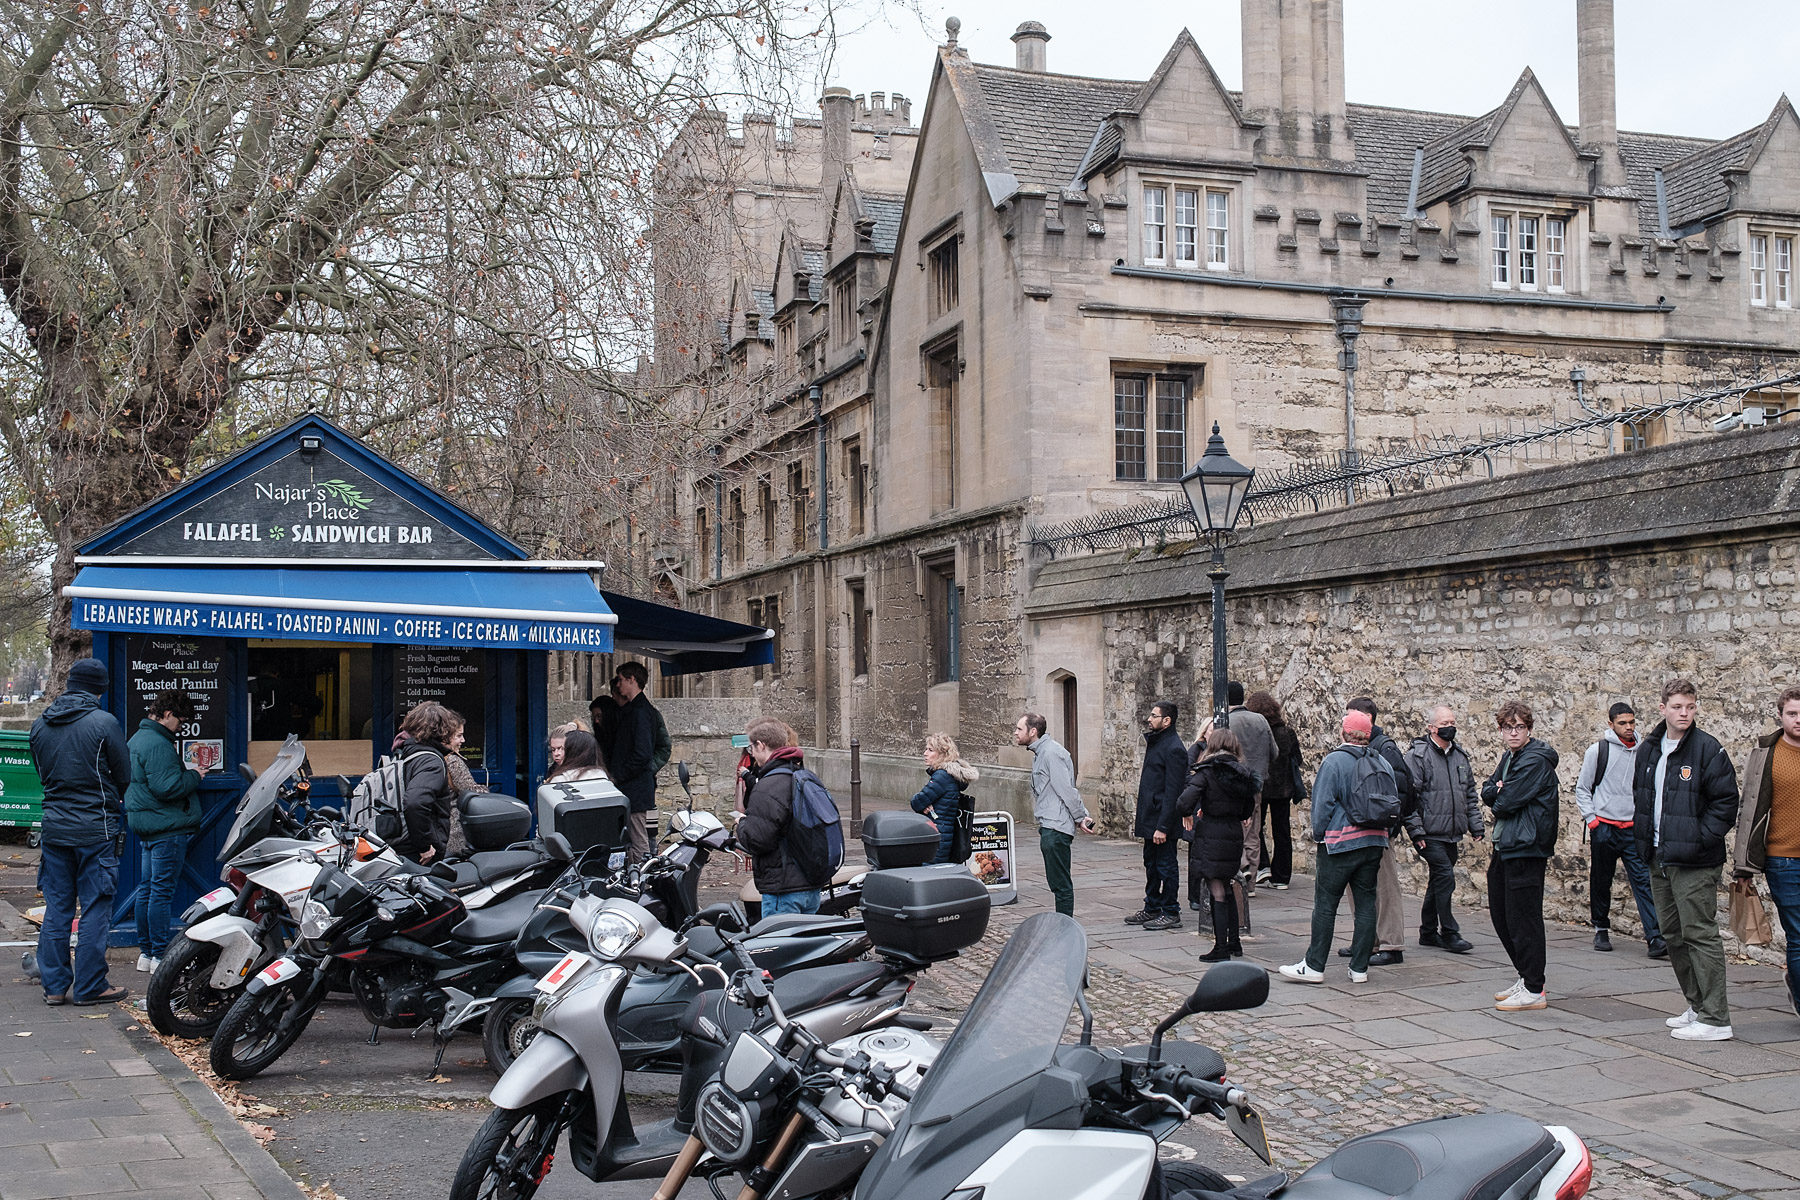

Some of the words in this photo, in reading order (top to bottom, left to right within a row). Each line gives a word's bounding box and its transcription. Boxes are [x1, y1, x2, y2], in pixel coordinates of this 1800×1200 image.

[254, 482, 327, 505] Najar's
[307, 501, 360, 520] Place
[183, 522, 262, 542] FALAFEL
[291, 524, 390, 543] SANDWICH
[398, 526, 433, 544] BAR
[83, 603, 150, 625] LEBANESE
[153, 607, 199, 628] WRAPS
[210, 610, 265, 630] FALAFEL
[276, 613, 332, 633] TOASTED
[335, 616, 380, 636] PANINI
[394, 619, 442, 638] COFFEE
[452, 621, 473, 640] ICE
[475, 622, 519, 642] CREAM
[528, 626, 601, 646] MILKSHAKES
[152, 641, 181, 650] Najar's
[173, 648, 194, 656] Place
[427, 654, 460, 664] Baguettes
[187, 660, 199, 670] all
[202, 660, 219, 673] day
[407, 665, 431, 676] Freshly
[433, 665, 457, 673] Ground
[459, 665, 478, 673] Coffee
[134, 678, 178, 690] Toasted
[181, 677, 218, 690] Panini
[427, 677, 466, 685] Milkshakes
[407, 688, 421, 696] Cold
[423, 688, 446, 696] Drinks
[4, 757, 30, 765] Waste
[263, 960, 284, 981] L
[546, 958, 574, 985] L
